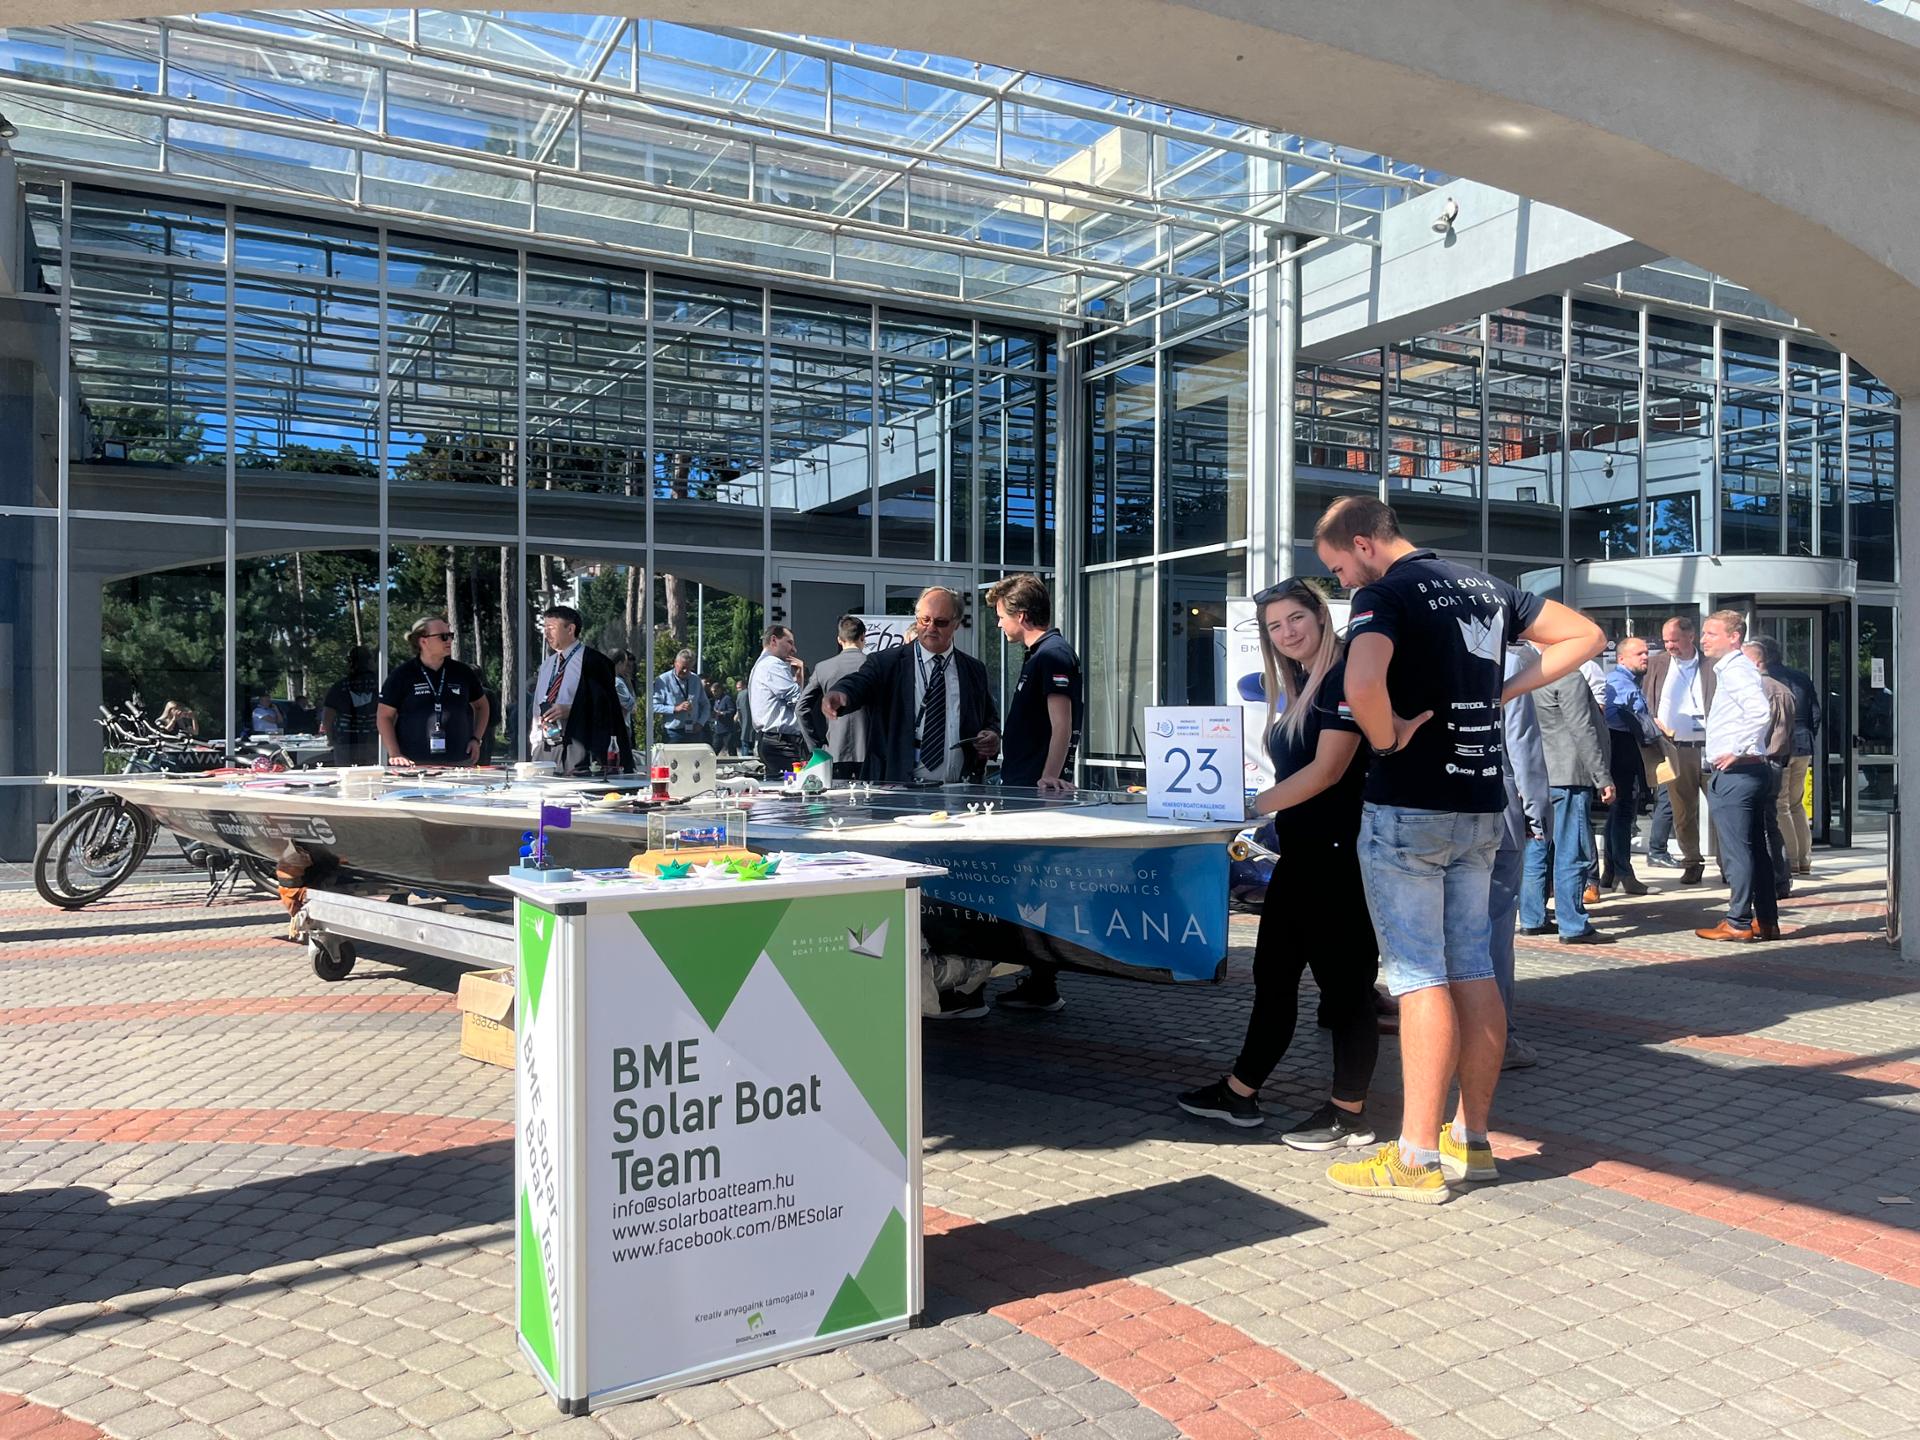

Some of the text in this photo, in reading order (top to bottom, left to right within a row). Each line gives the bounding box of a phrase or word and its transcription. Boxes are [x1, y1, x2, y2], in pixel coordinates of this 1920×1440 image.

[1418, 579, 1453, 593] BME
[1428, 596, 1463, 610] BOAT
[1164, 747, 1222, 795] 23
[940, 870, 1160, 896] CHNOLOGY AND ECONOMICS
[1013, 863, 1114, 878] UNIVERSITY
[1137, 869, 1158, 880] OF
[920, 904, 999, 923] OAT TEAM
[950, 891, 995, 905] SOLAR
[1073, 904, 1208, 945] LANA
[613, 1038, 700, 1093] BME
[613, 1074, 821, 1144] Solar Boat
[525, 1117, 544, 1208] Boat
[537, 1118, 559, 1217] Solar
[611, 1145, 720, 1195] Team
[612, 1173, 795, 1219] info@solarboatteam.hu
[612, 1194, 796, 1241] www.solarboatteam.hu
[612, 1204, 844, 1263] www.facebook.com/BMESolar
